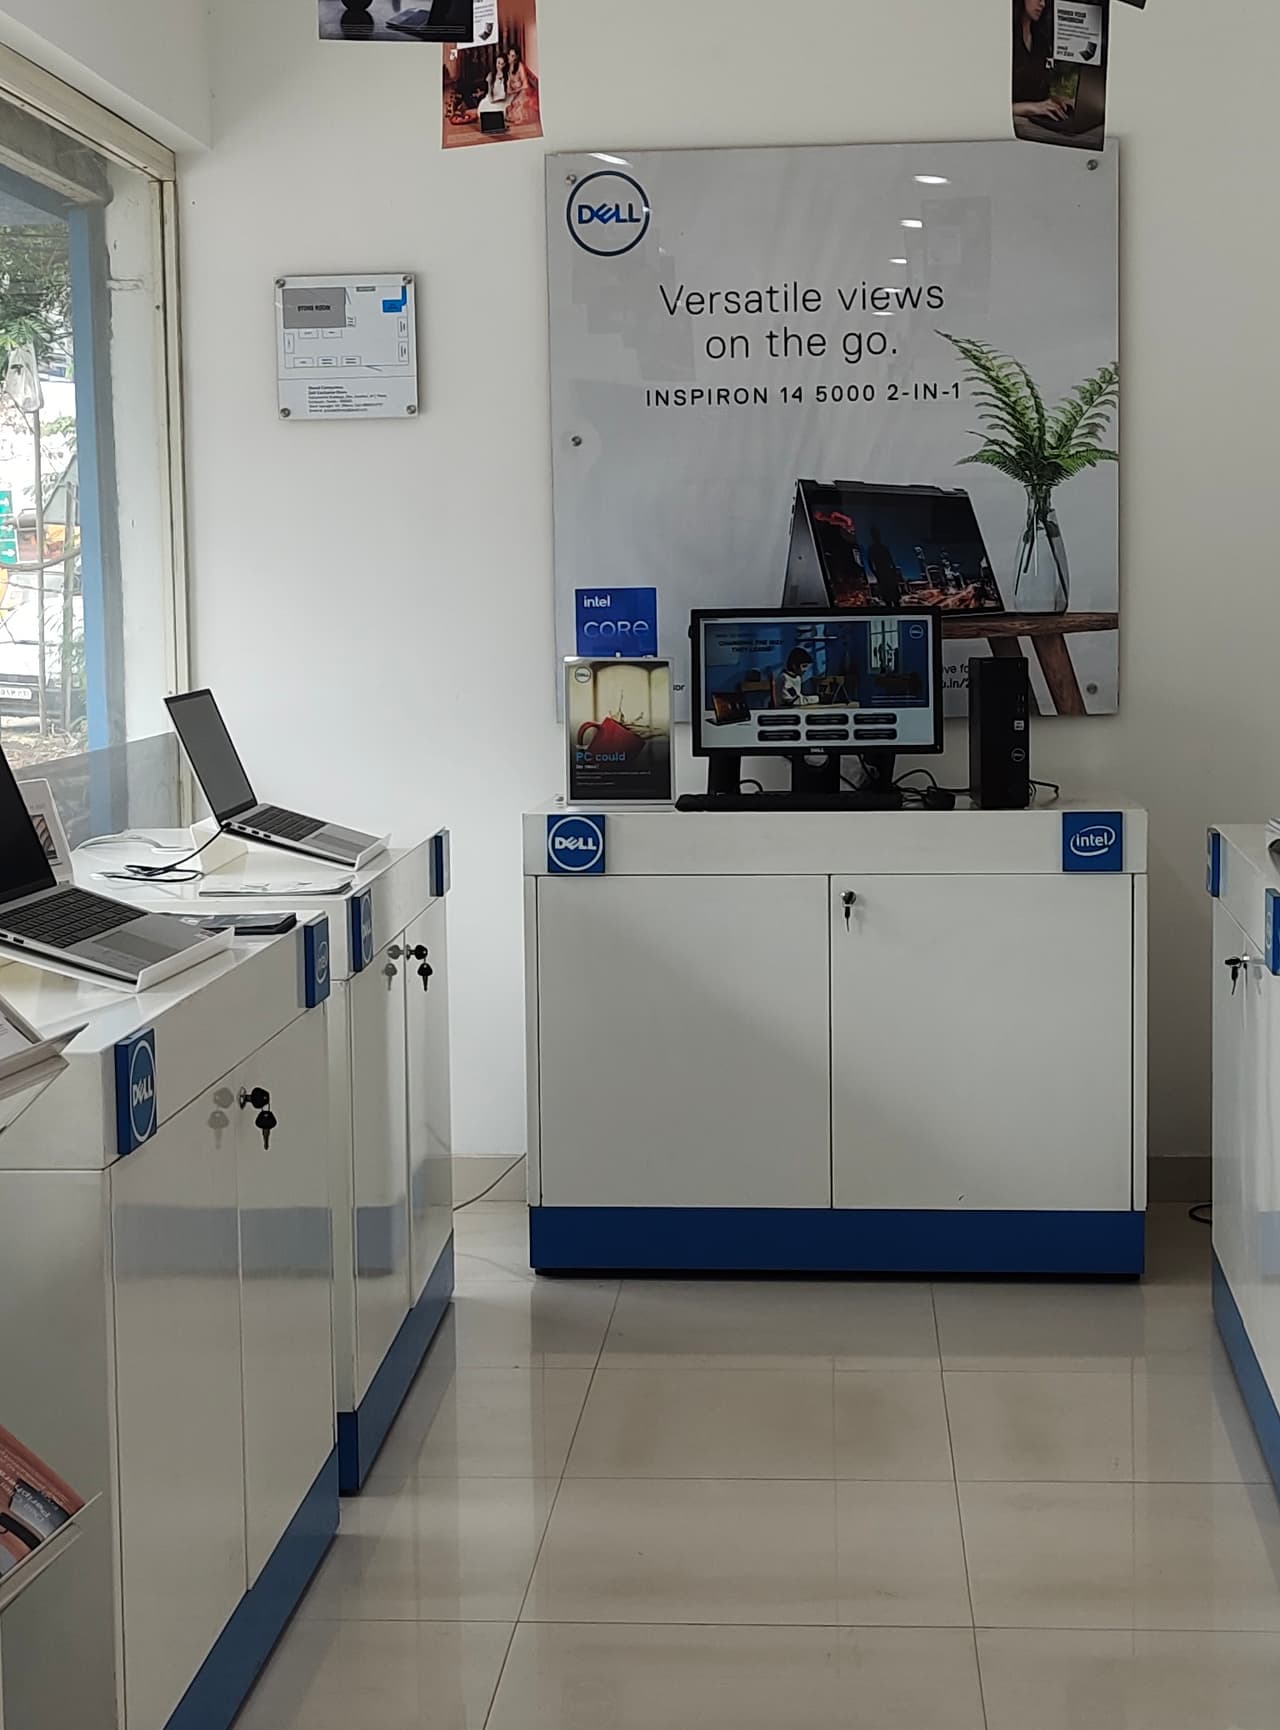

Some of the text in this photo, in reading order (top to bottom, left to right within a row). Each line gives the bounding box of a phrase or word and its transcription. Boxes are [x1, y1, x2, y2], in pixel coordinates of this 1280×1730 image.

[578, 203, 641, 224] DELL
[659, 281, 945, 316] Versatile views
[705, 326, 898, 364] on the go.
[646, 382, 961, 407] INSPIRON 14 5000 2-IN-1
[583, 595, 611, 608] intel
[595, 751, 626, 762] could
[555, 835, 597, 851] DELL
[1074, 831, 1110, 848] intel
[132, 1075, 153, 1107] DELL
